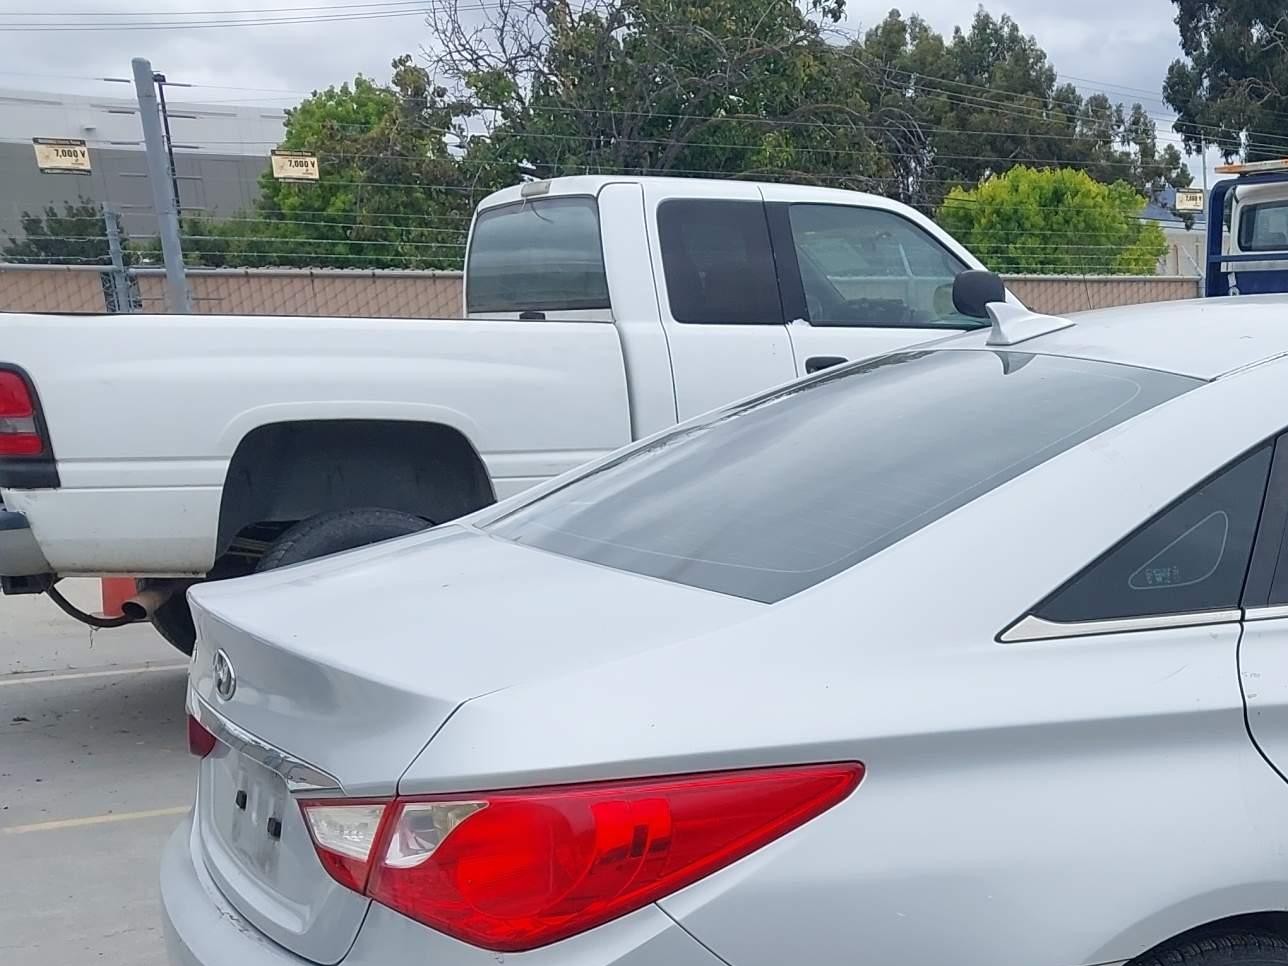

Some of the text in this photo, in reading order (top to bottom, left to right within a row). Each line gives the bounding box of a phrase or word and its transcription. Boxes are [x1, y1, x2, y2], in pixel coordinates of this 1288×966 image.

[54, 149, 86, 159] 7,000 V
[288, 160, 316, 168] 7,000 V
